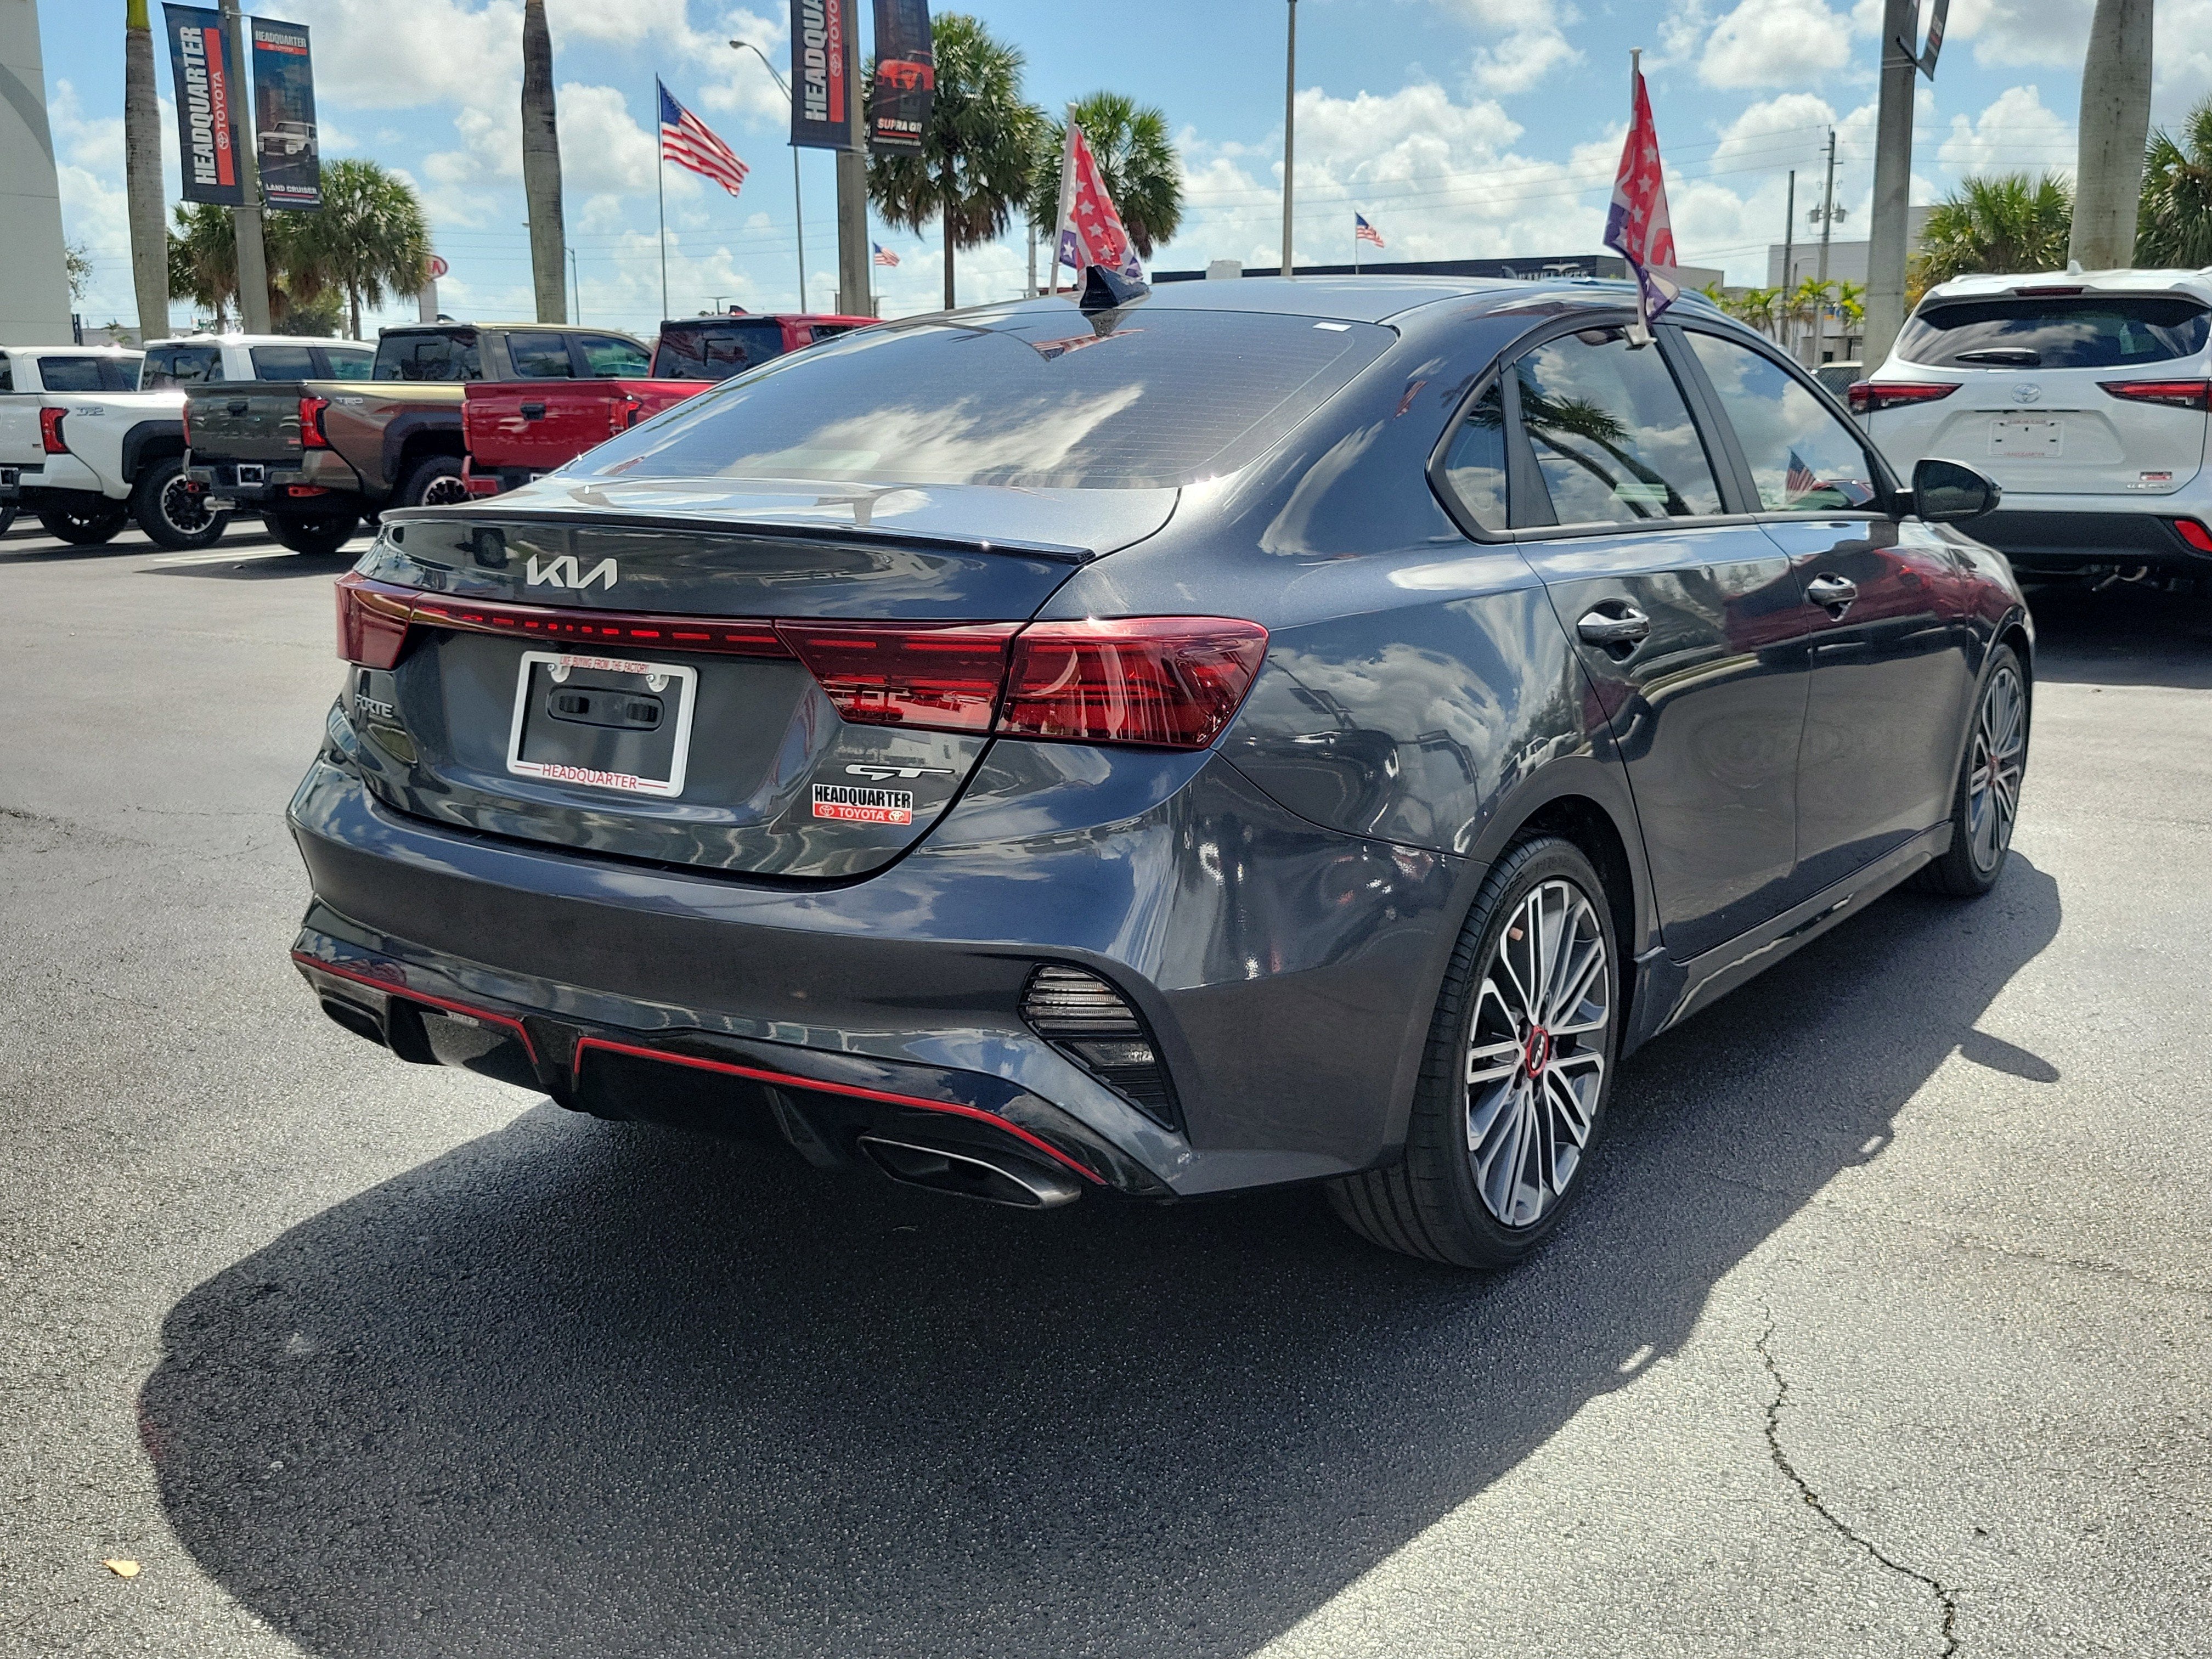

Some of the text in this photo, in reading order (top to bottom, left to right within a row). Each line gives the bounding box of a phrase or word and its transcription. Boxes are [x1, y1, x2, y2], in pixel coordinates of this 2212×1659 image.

[255, 30, 307, 48] HEADQUARTER
[180, 27, 218, 185] HEADQUARTER
[212, 71, 227, 129] TOYOTA
[877, 117, 922, 133] SUPRA GR
[266, 183, 318, 195] LAND CRUISER
[527, 554, 618, 590] KIA
[560, 656, 650, 674] LIKE BUYING FROM THE FACTORY
[355, 694, 393, 718] FORTE
[543, 765, 636, 789] HEADQUARTER
[845, 764, 955, 781] GT
[815, 785, 911, 809] HEADQUARTER
[838, 807, 885, 821] TOYOTA
